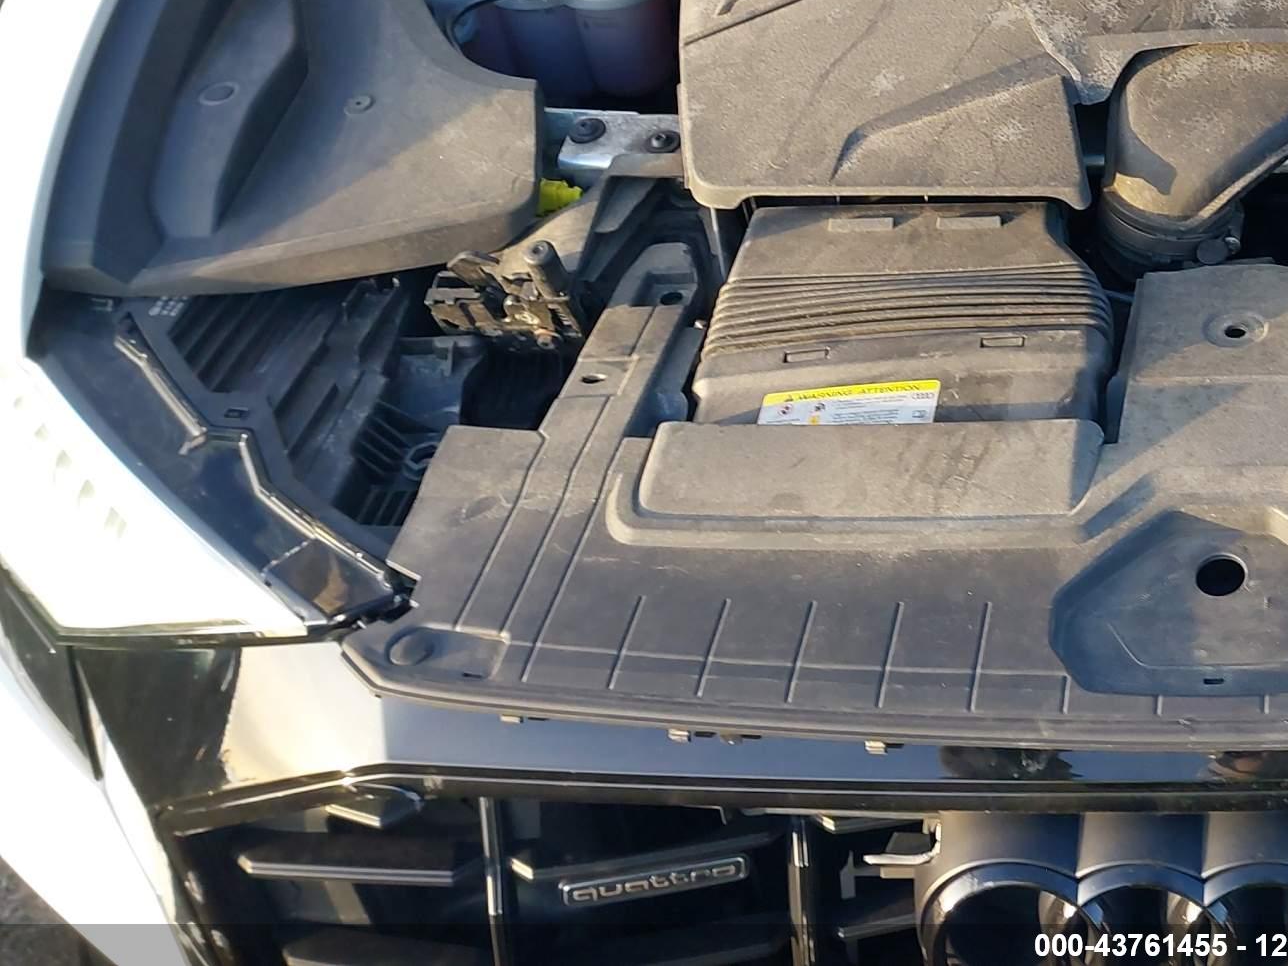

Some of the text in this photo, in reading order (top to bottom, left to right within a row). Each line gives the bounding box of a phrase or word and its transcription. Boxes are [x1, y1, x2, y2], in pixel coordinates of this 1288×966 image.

[798, 384, 921, 401] WARNING ATTENTION
[571, 864, 737, 903] quattro
